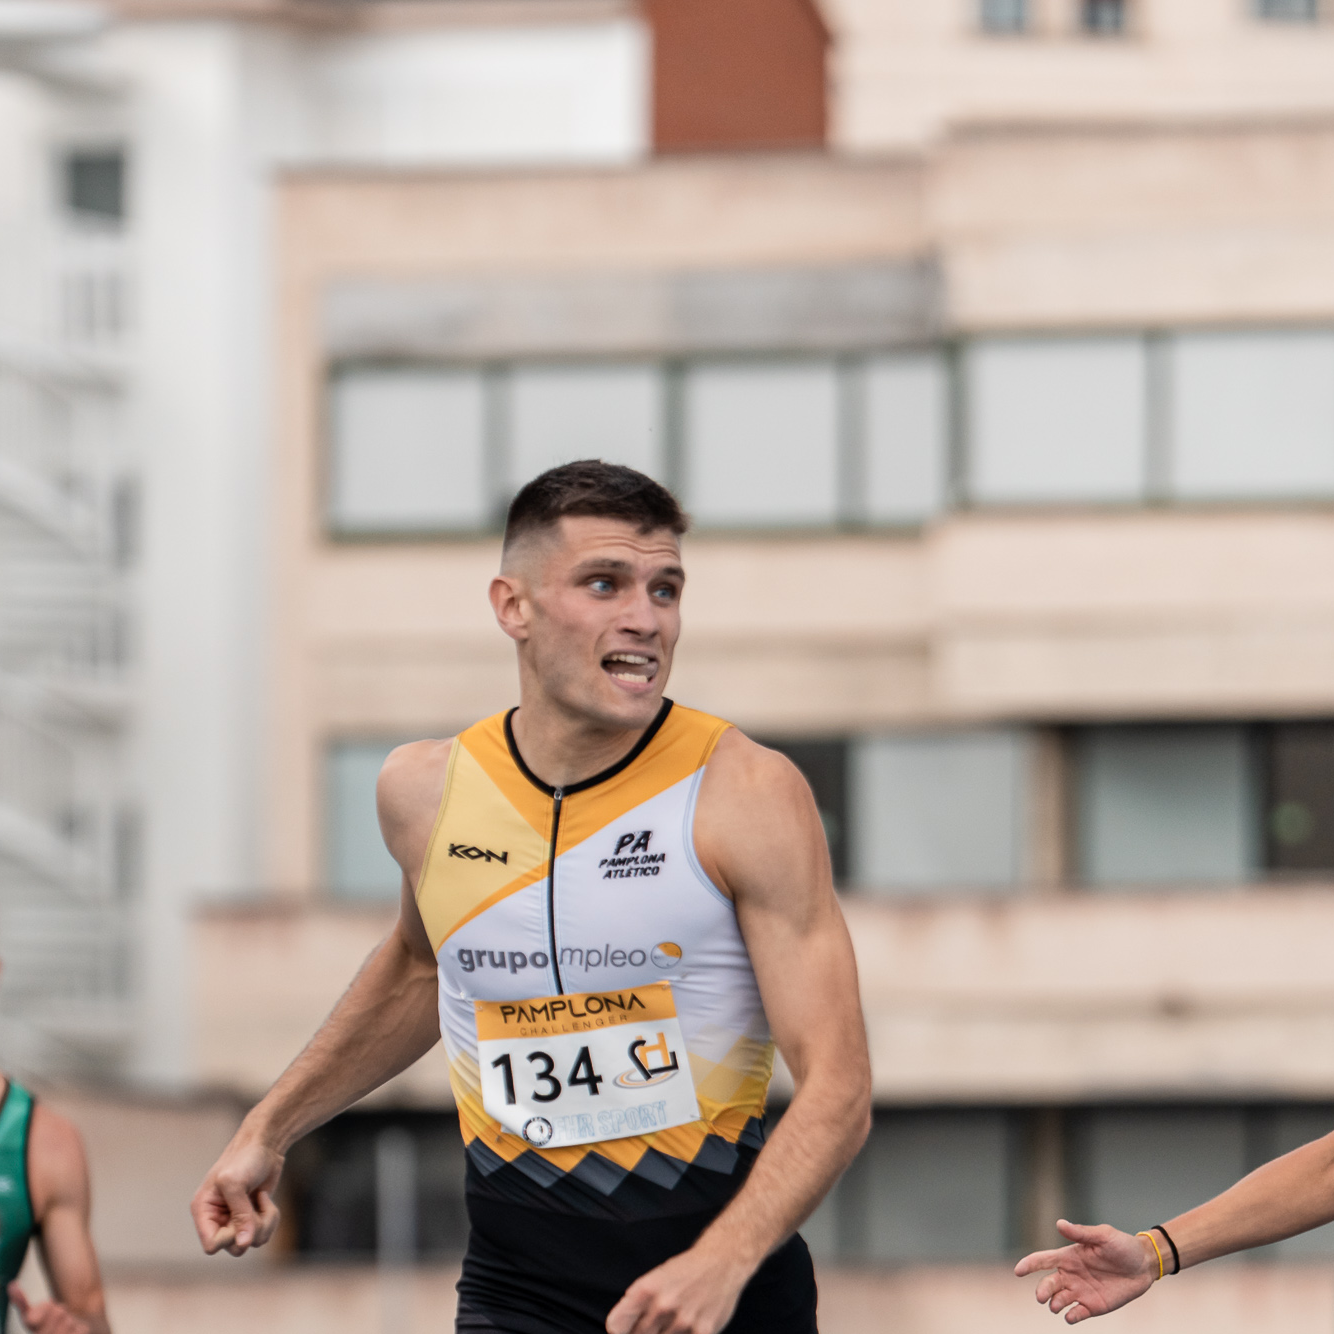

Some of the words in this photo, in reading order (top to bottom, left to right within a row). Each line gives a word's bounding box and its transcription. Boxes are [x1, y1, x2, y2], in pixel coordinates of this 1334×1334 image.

[613, 831, 652, 855] PA
[598, 853, 666, 868] PAMPLONA
[457, 948, 549, 974] grupo
[558, 943, 647, 972] mpleo
[499, 993, 646, 1024] PAMPLONA
[520, 1014, 628, 1036] CHALLENGER
[491, 1046, 603, 1105] 134
[597, 1100, 667, 1137] SPORT
